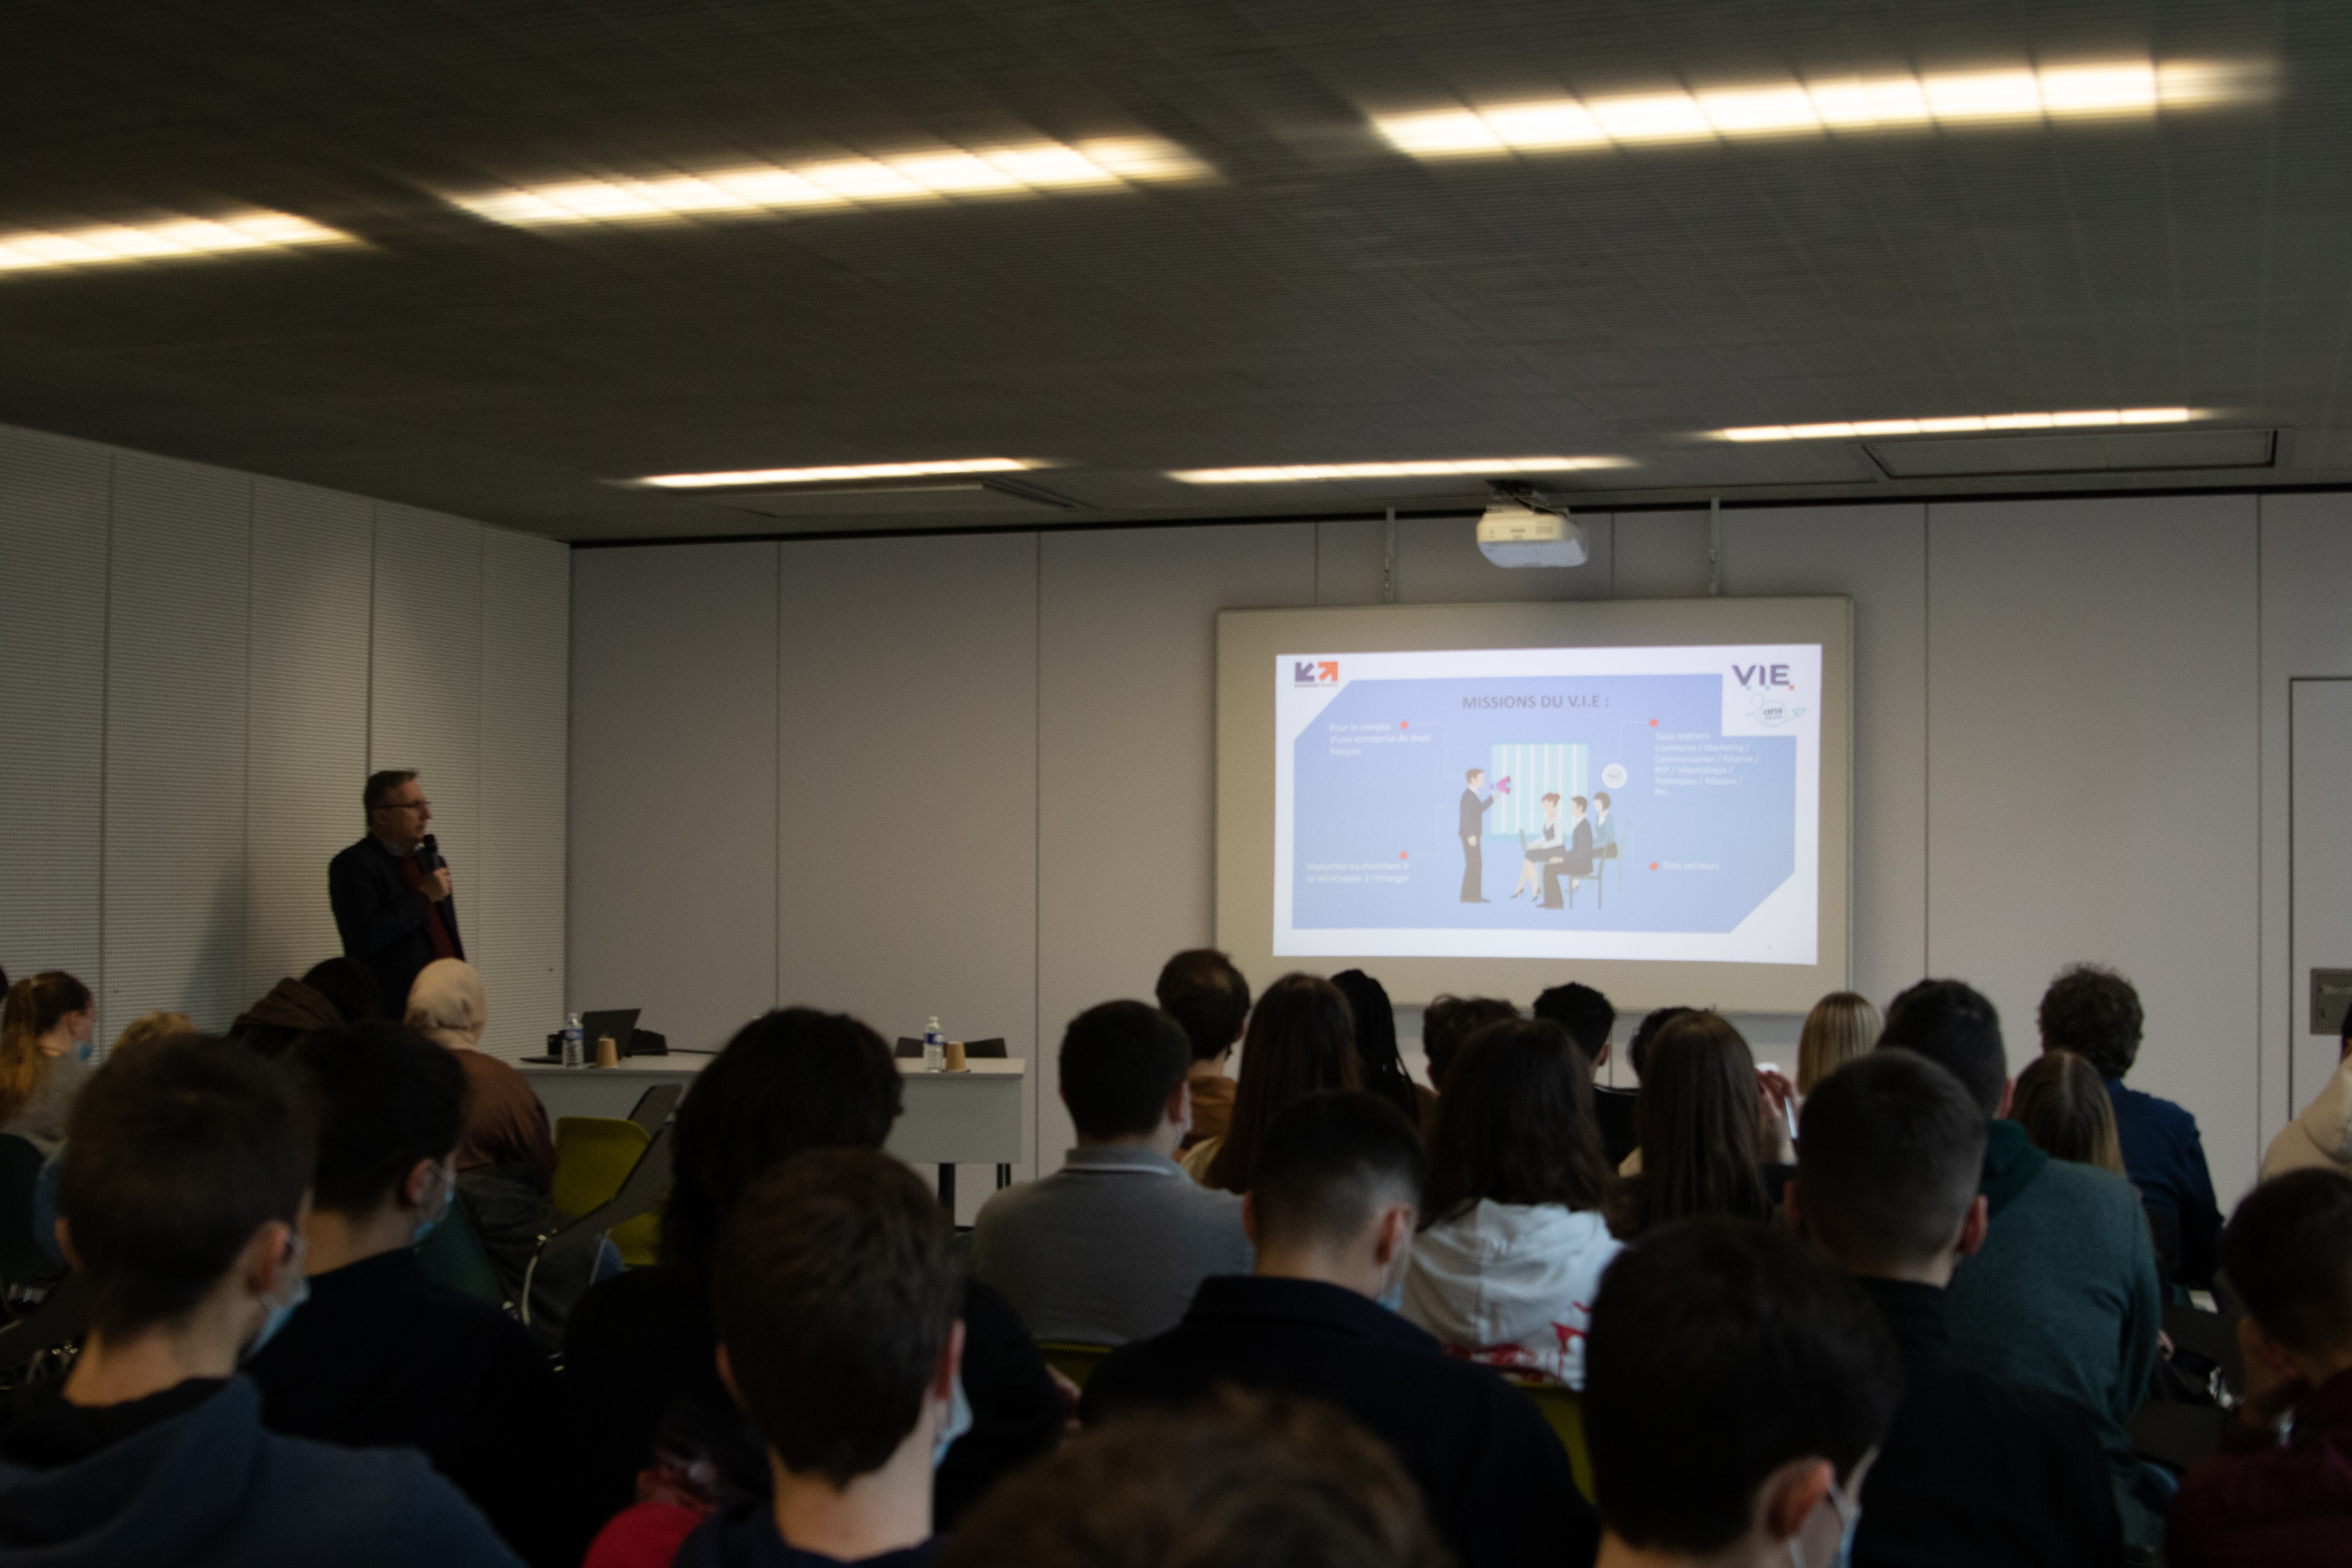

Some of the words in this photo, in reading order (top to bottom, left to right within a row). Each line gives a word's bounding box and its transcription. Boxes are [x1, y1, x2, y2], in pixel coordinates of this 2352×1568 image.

[1463, 695, 1535, 709] MISSIONS
[1541, 695, 1563, 708] DU
[1568, 695, 1599, 708] V.I.E
[1354, 735, 1396, 744] entreprise
[1410, 734, 1430, 742] droit
[1656, 732, 1675, 740] Tous
[1704, 744, 1744, 753] Marketing
[1654, 755, 1715, 764] Communication
[1361, 862, 1401, 871] cherchant
[1662, 860, 1681, 870] Tous
[1684, 862, 1720, 870] secteurs
